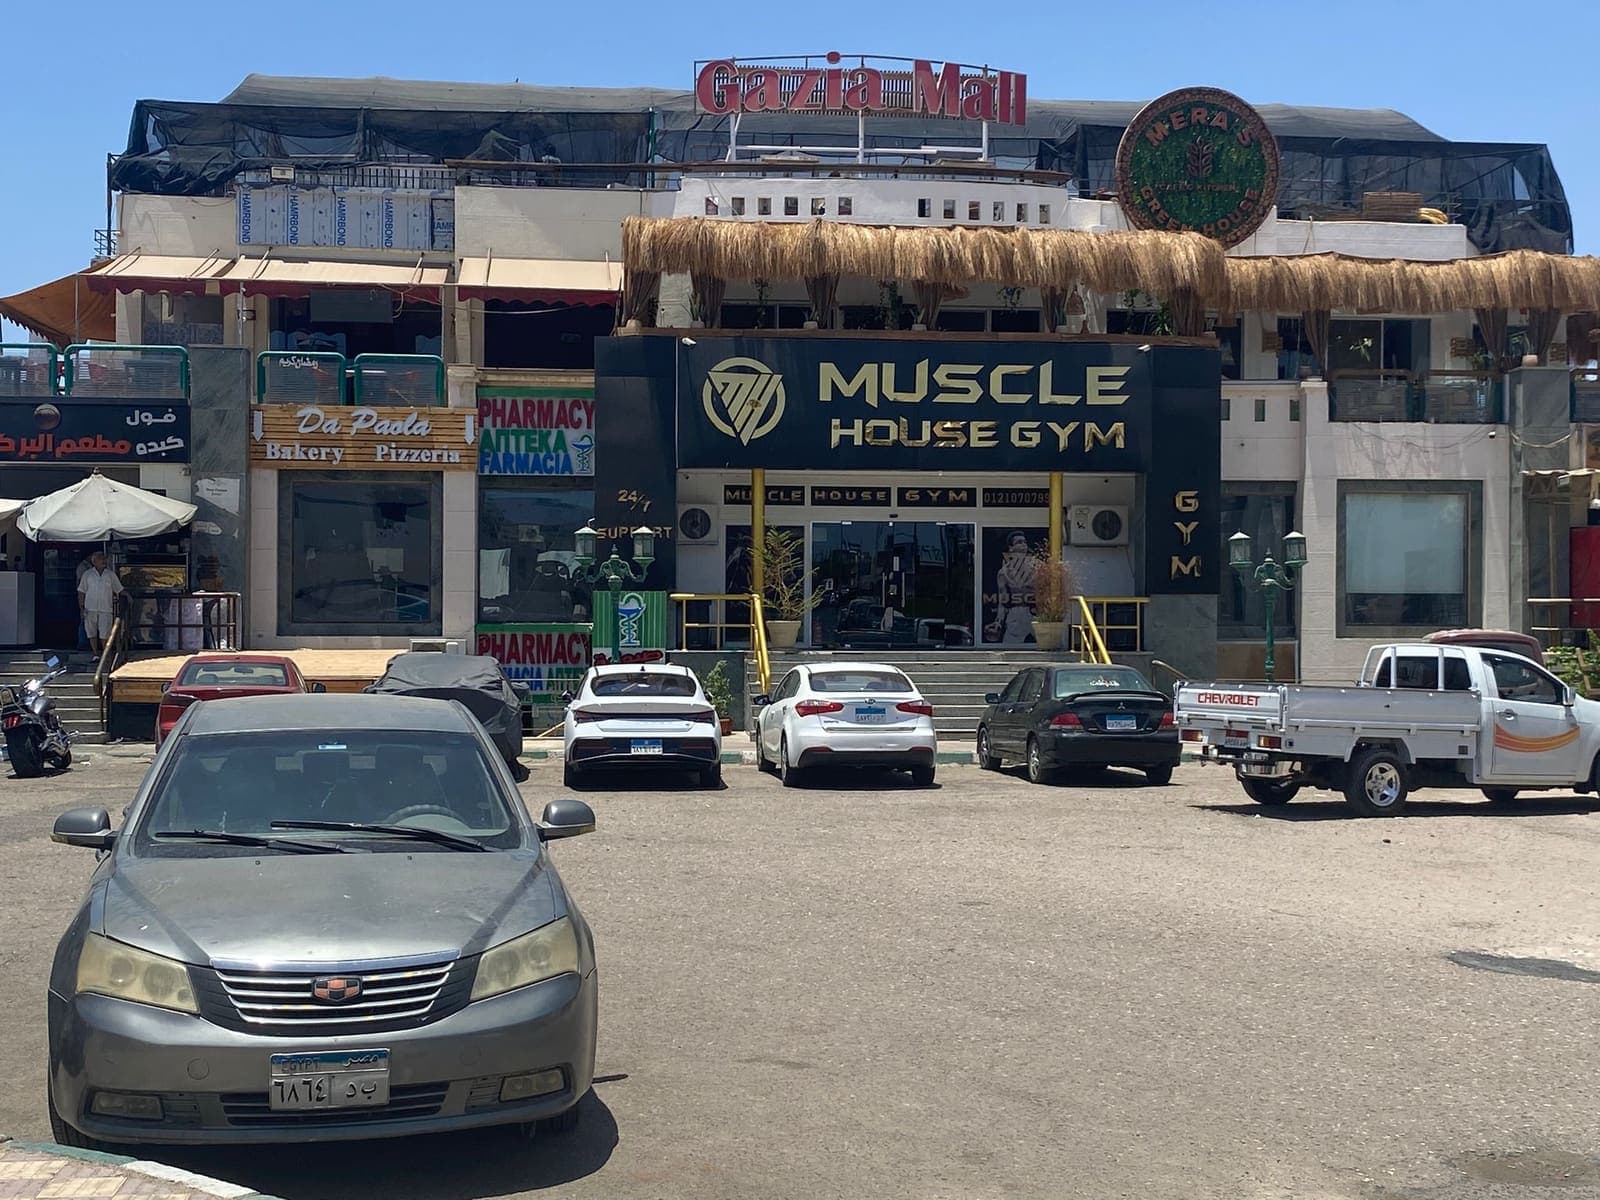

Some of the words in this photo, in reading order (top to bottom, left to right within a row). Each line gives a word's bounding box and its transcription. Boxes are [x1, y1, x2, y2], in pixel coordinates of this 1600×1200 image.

[696, 51, 887, 115] Gazia
[913, 59, 1027, 126] Mall
[241, 193, 251, 243] HAMRBOND
[289, 194, 299, 244] HAMRBOND
[337, 196, 346, 246] HAMRBOND
[384, 198, 394, 248] HAMRBOND
[819, 359, 1131, 407] MUSCLE
[126, 408, 177, 426] فول
[296, 407, 341, 435] Da
[349, 407, 431, 437] Paola
[478, 398, 596, 429] PHARMACY
[56, 433, 132, 458] مطعم
[831, 418, 999, 449] HOUSE
[1010, 420, 1125, 453] GYM
[265, 442, 345, 465] Bakery
[374, 443, 460, 464] Pizzeria
[480, 452, 573, 474] FARMACIA
[725, 489, 802, 501] MUCLE
[814, 489, 888, 501] HOUSE
[905, 489, 968, 501] GYM
[1197, 692, 1260, 706] CHEVROLET
[281, 1057, 321, 1073] EGYPT
[343, 1053, 379, 1067] مصر
[273, 1077, 327, 1103] ٦٨٦٤
